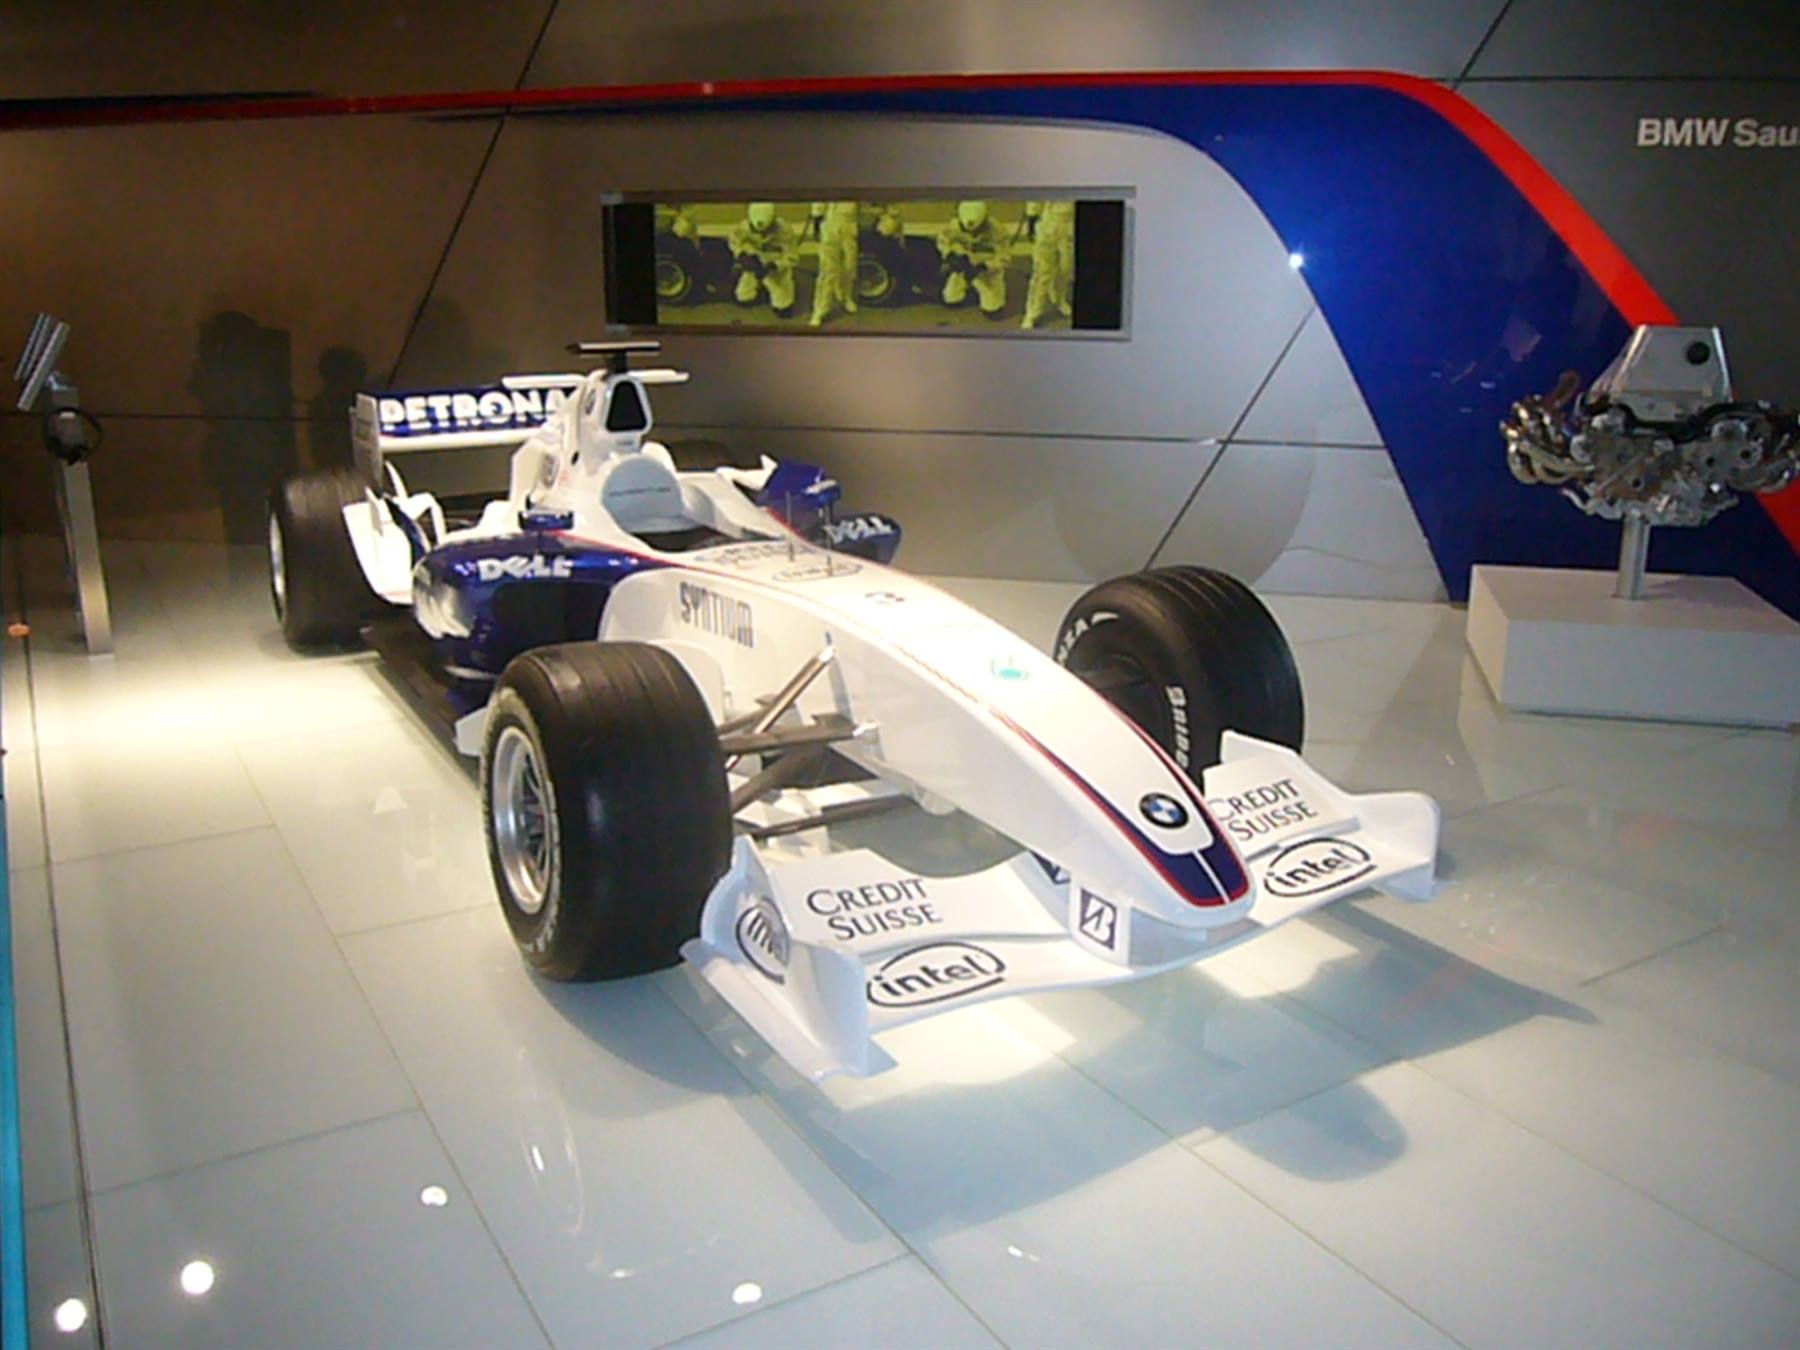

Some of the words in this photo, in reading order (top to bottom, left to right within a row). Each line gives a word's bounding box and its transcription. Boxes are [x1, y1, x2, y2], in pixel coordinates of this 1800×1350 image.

[1637, 118, 1730, 146] BMW
[477, 555, 572, 581] DELL
[1208, 778, 1299, 822] CREDIT
[1228, 800, 1318, 842] SUISSE
[1266, 848, 1358, 888] intel
[806, 877, 928, 916] CREDIT
[827, 902, 944, 941] SUISSE
[874, 954, 994, 997] intel
